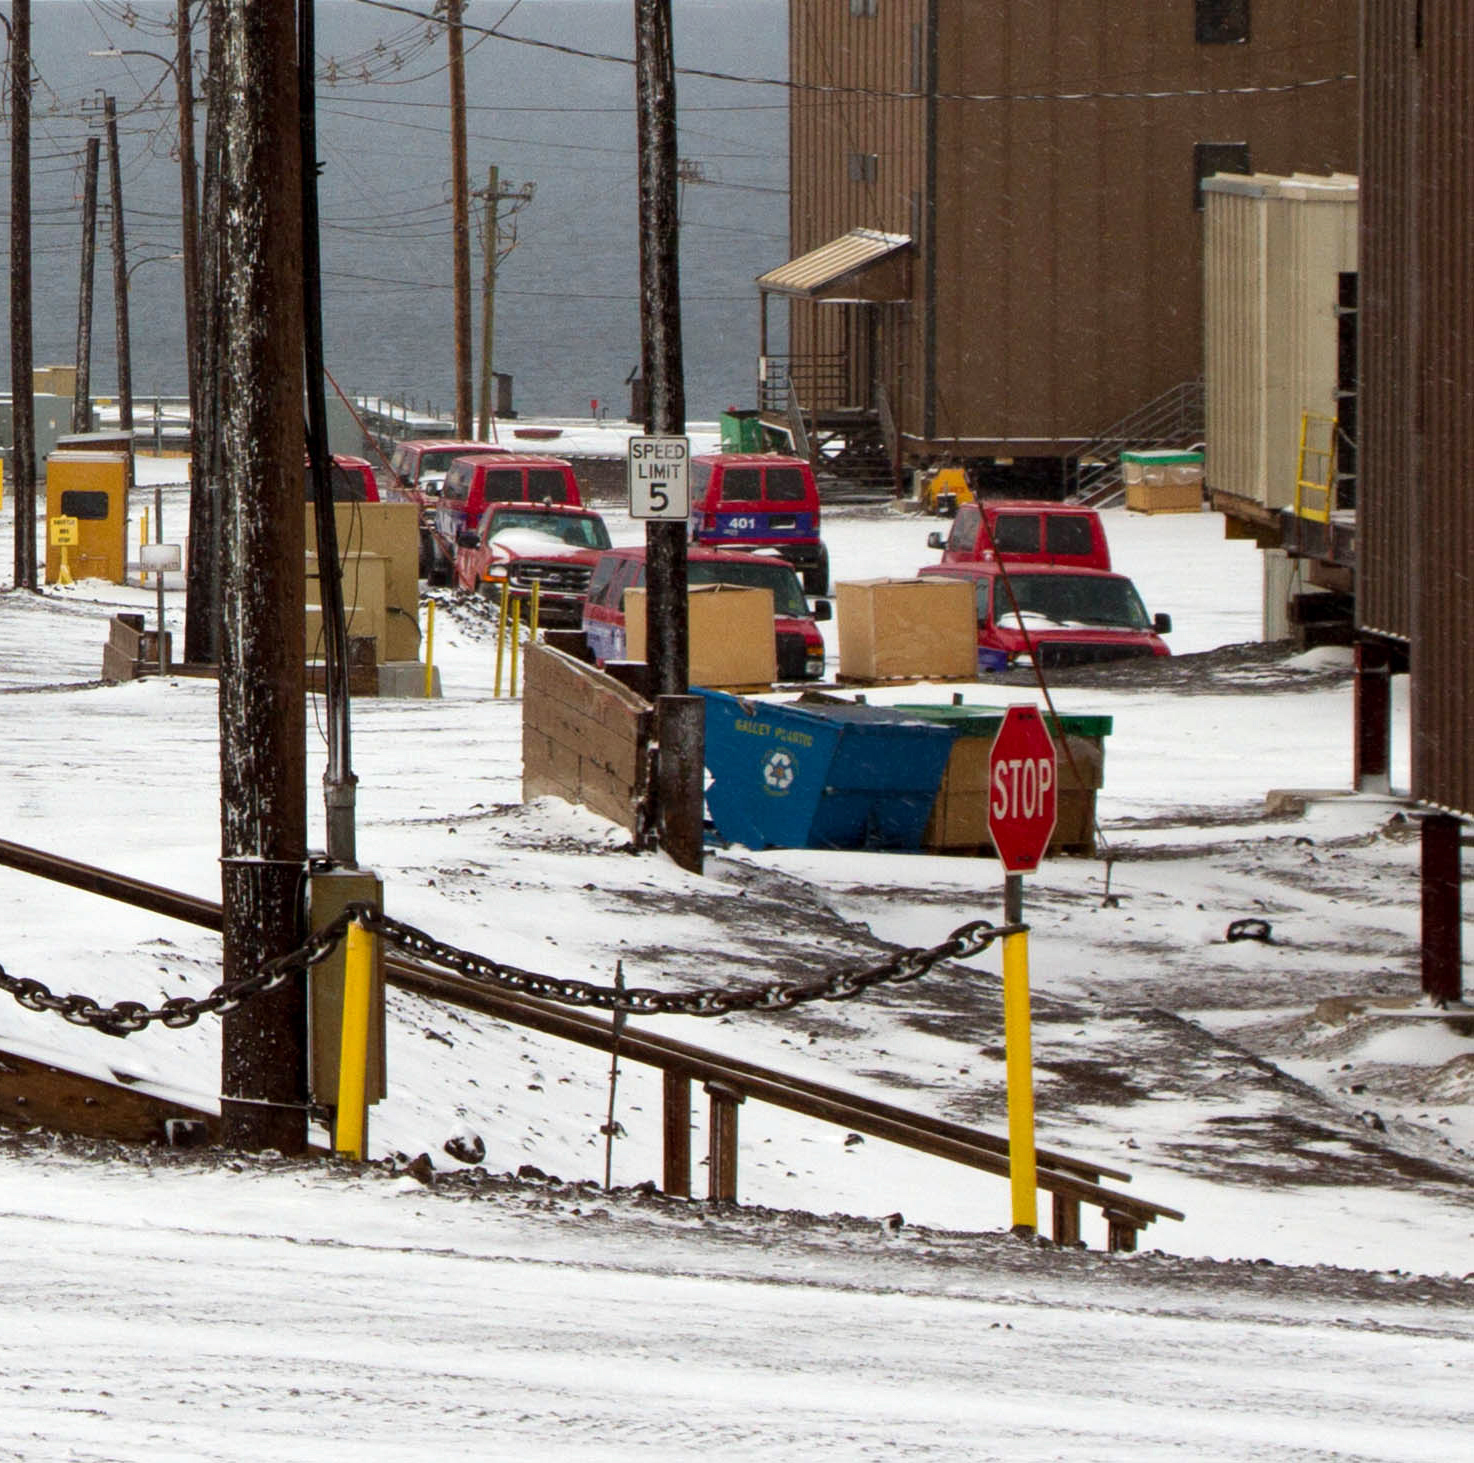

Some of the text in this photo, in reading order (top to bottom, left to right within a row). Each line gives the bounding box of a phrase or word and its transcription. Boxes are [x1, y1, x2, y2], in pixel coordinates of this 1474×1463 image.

[632, 444, 685, 460] SPEED
[638, 464, 681, 479] LIMIT
[649, 482, 669, 512] 5
[729, 518, 755, 529] 401
[992, 758, 1053, 820] STOP
